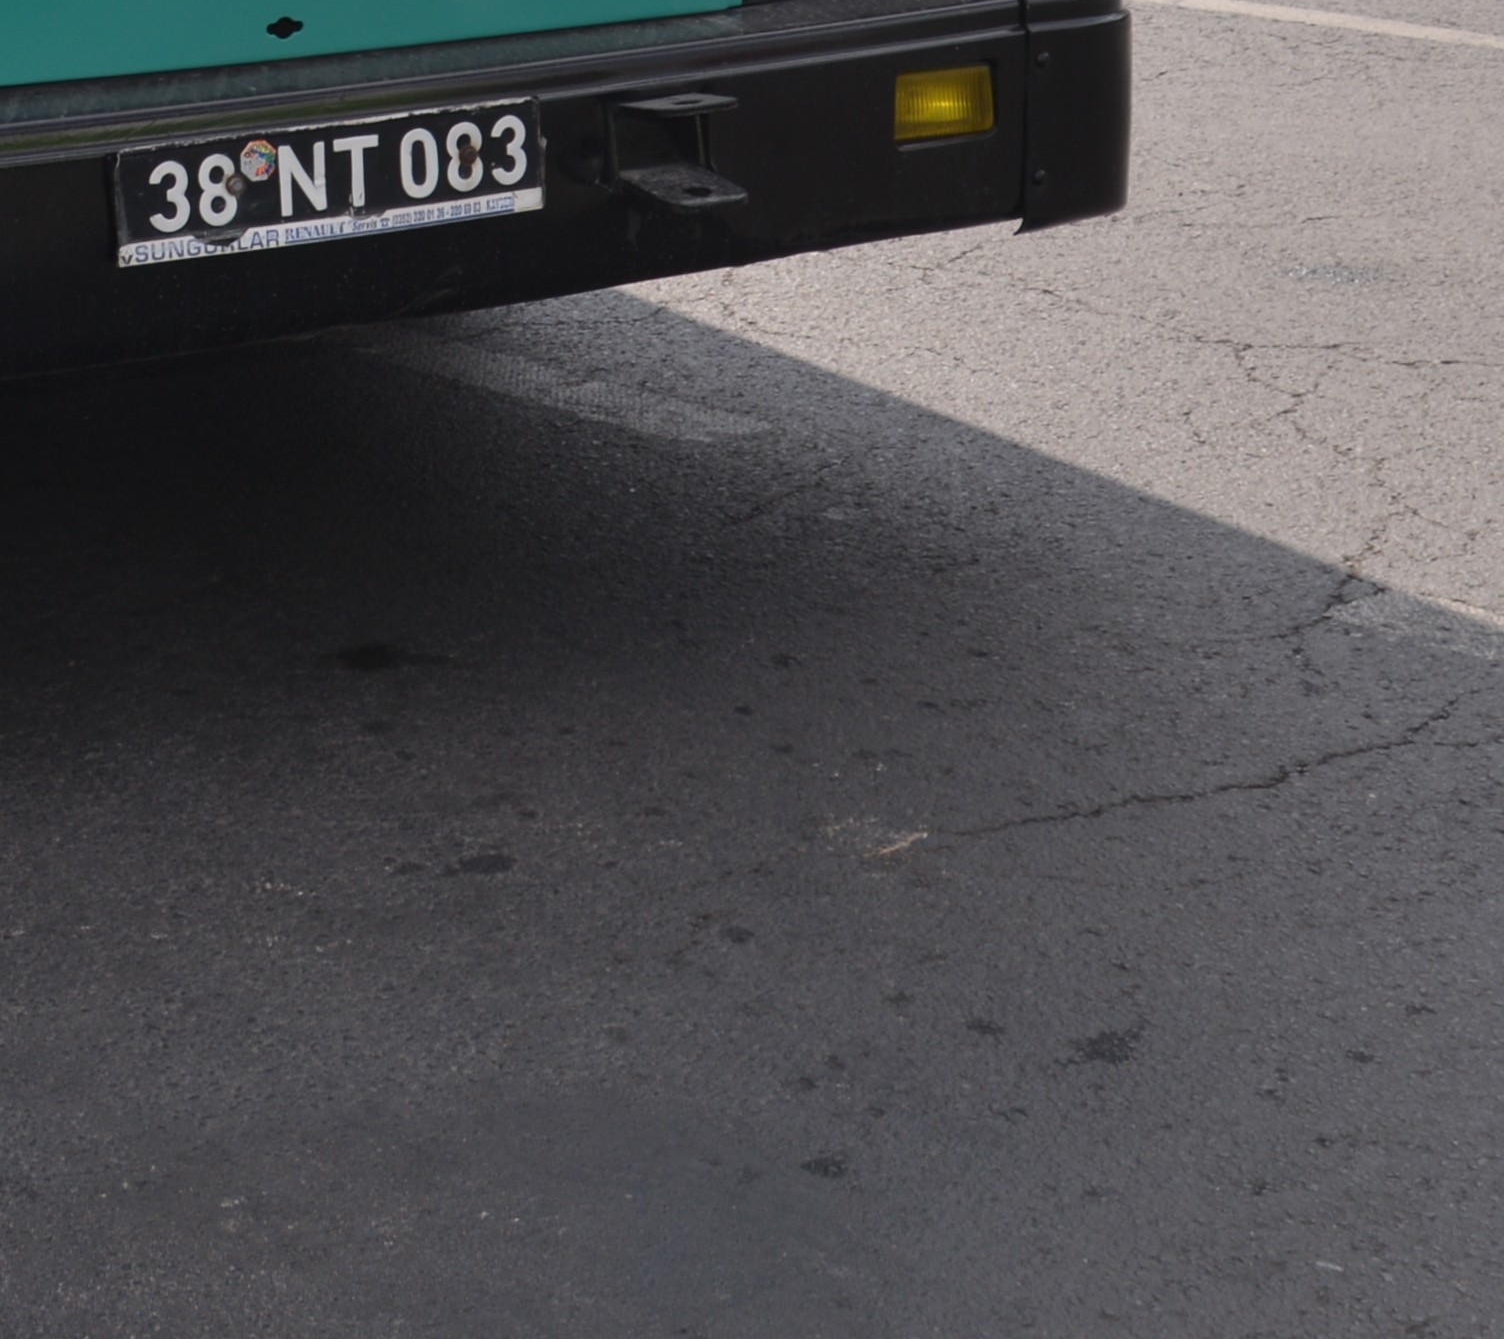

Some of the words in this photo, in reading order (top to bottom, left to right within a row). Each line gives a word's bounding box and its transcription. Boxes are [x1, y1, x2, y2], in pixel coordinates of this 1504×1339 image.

[148, 153, 239, 233] 38
[277, 134, 379, 217] NT
[400, 114, 528, 199] 083
